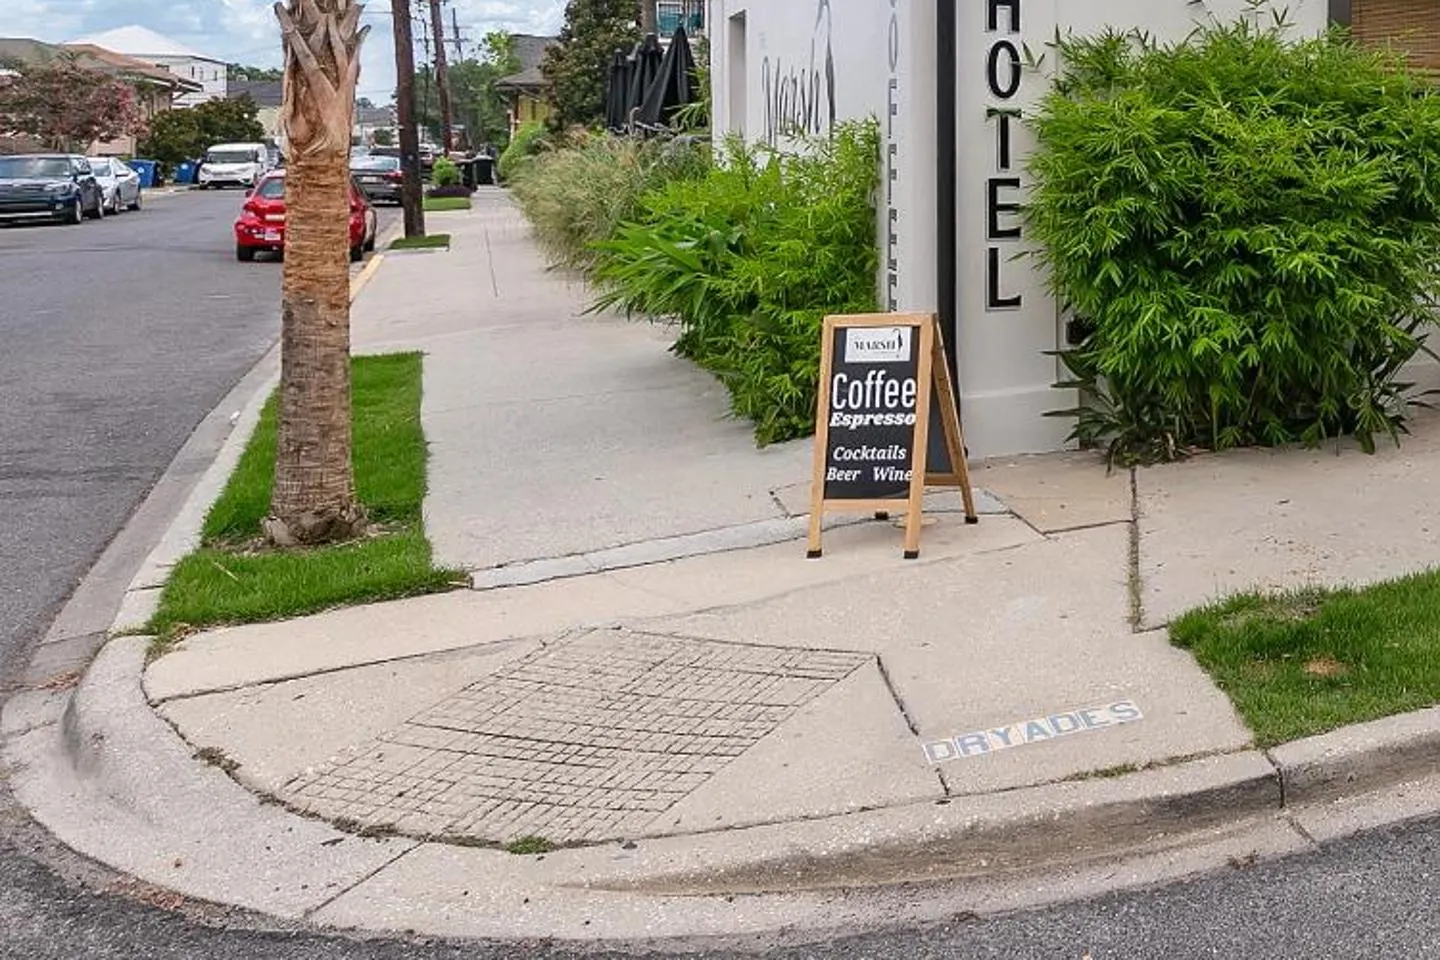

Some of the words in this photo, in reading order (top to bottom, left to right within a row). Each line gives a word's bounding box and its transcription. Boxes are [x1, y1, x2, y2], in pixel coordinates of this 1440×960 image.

[832, 370, 917, 410] Coffee
[829, 411, 917, 430] Espresso
[833, 445, 907, 461] Cocktails
[827, 467, 862, 482] Beer
[873, 467, 913, 482] Wine
[925, 701, 1140, 760] DRYADES
